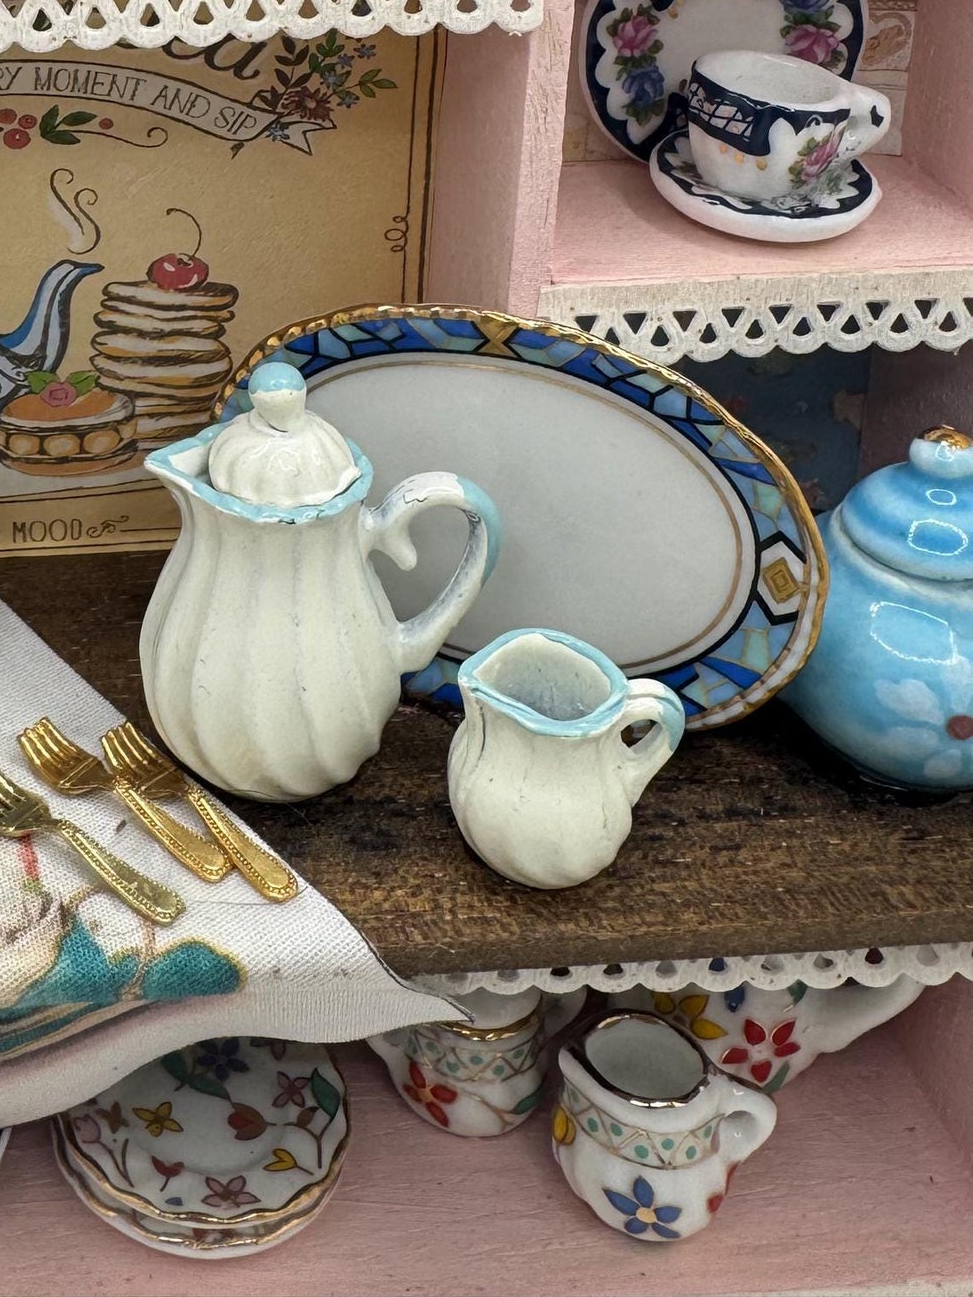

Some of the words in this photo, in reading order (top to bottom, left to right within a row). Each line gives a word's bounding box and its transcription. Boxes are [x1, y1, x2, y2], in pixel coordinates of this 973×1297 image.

[34, 66, 147, 102] MOMENT
[150, 85, 211, 119] AND
[213, 106, 258, 136] SIP
[12, 517, 83, 544] MOOD
